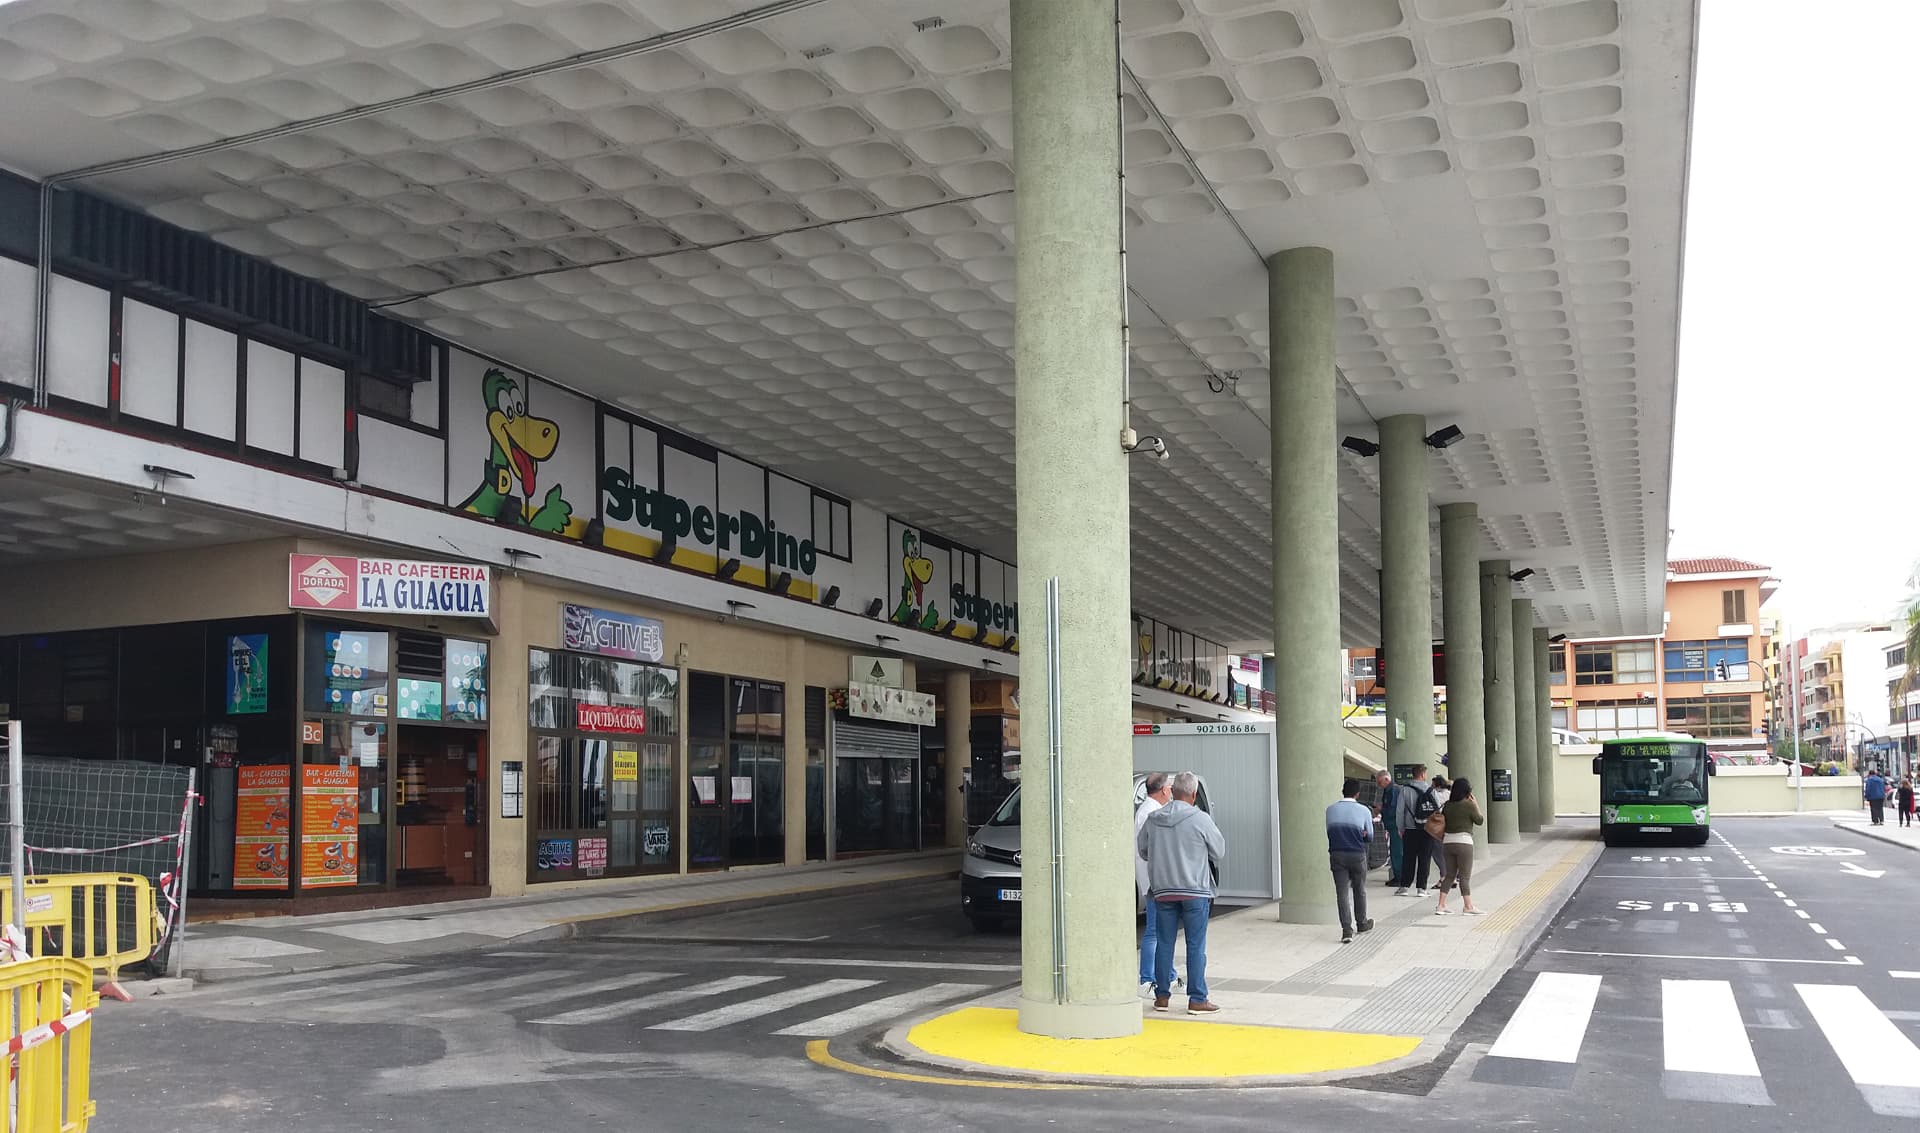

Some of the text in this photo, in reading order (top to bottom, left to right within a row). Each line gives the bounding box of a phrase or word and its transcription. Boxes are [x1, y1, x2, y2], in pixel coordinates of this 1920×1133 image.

[603, 466, 817, 576] SuperDino
[360, 560, 486, 581] BAR CAFETERIA
[303, 576, 345, 588] DORADA
[361, 577, 485, 613] LA GUAGUA
[951, 582, 1018, 634] Super
[579, 616, 652, 655] ACTIVE
[579, 710, 644, 730] LIQUIDACIÓN
[303, 724, 321, 742] Bc
[1196, 724, 1256, 733] 902 10 86 86
[1621, 745, 1636, 756] 376
[247, 778, 256, 786] LA
[312, 777, 349, 785] LA GUAGUA
[647, 832, 667, 845] VANS
[539, 842, 573, 856] ACTIVE
[1616, 900, 1748, 912] BUS
